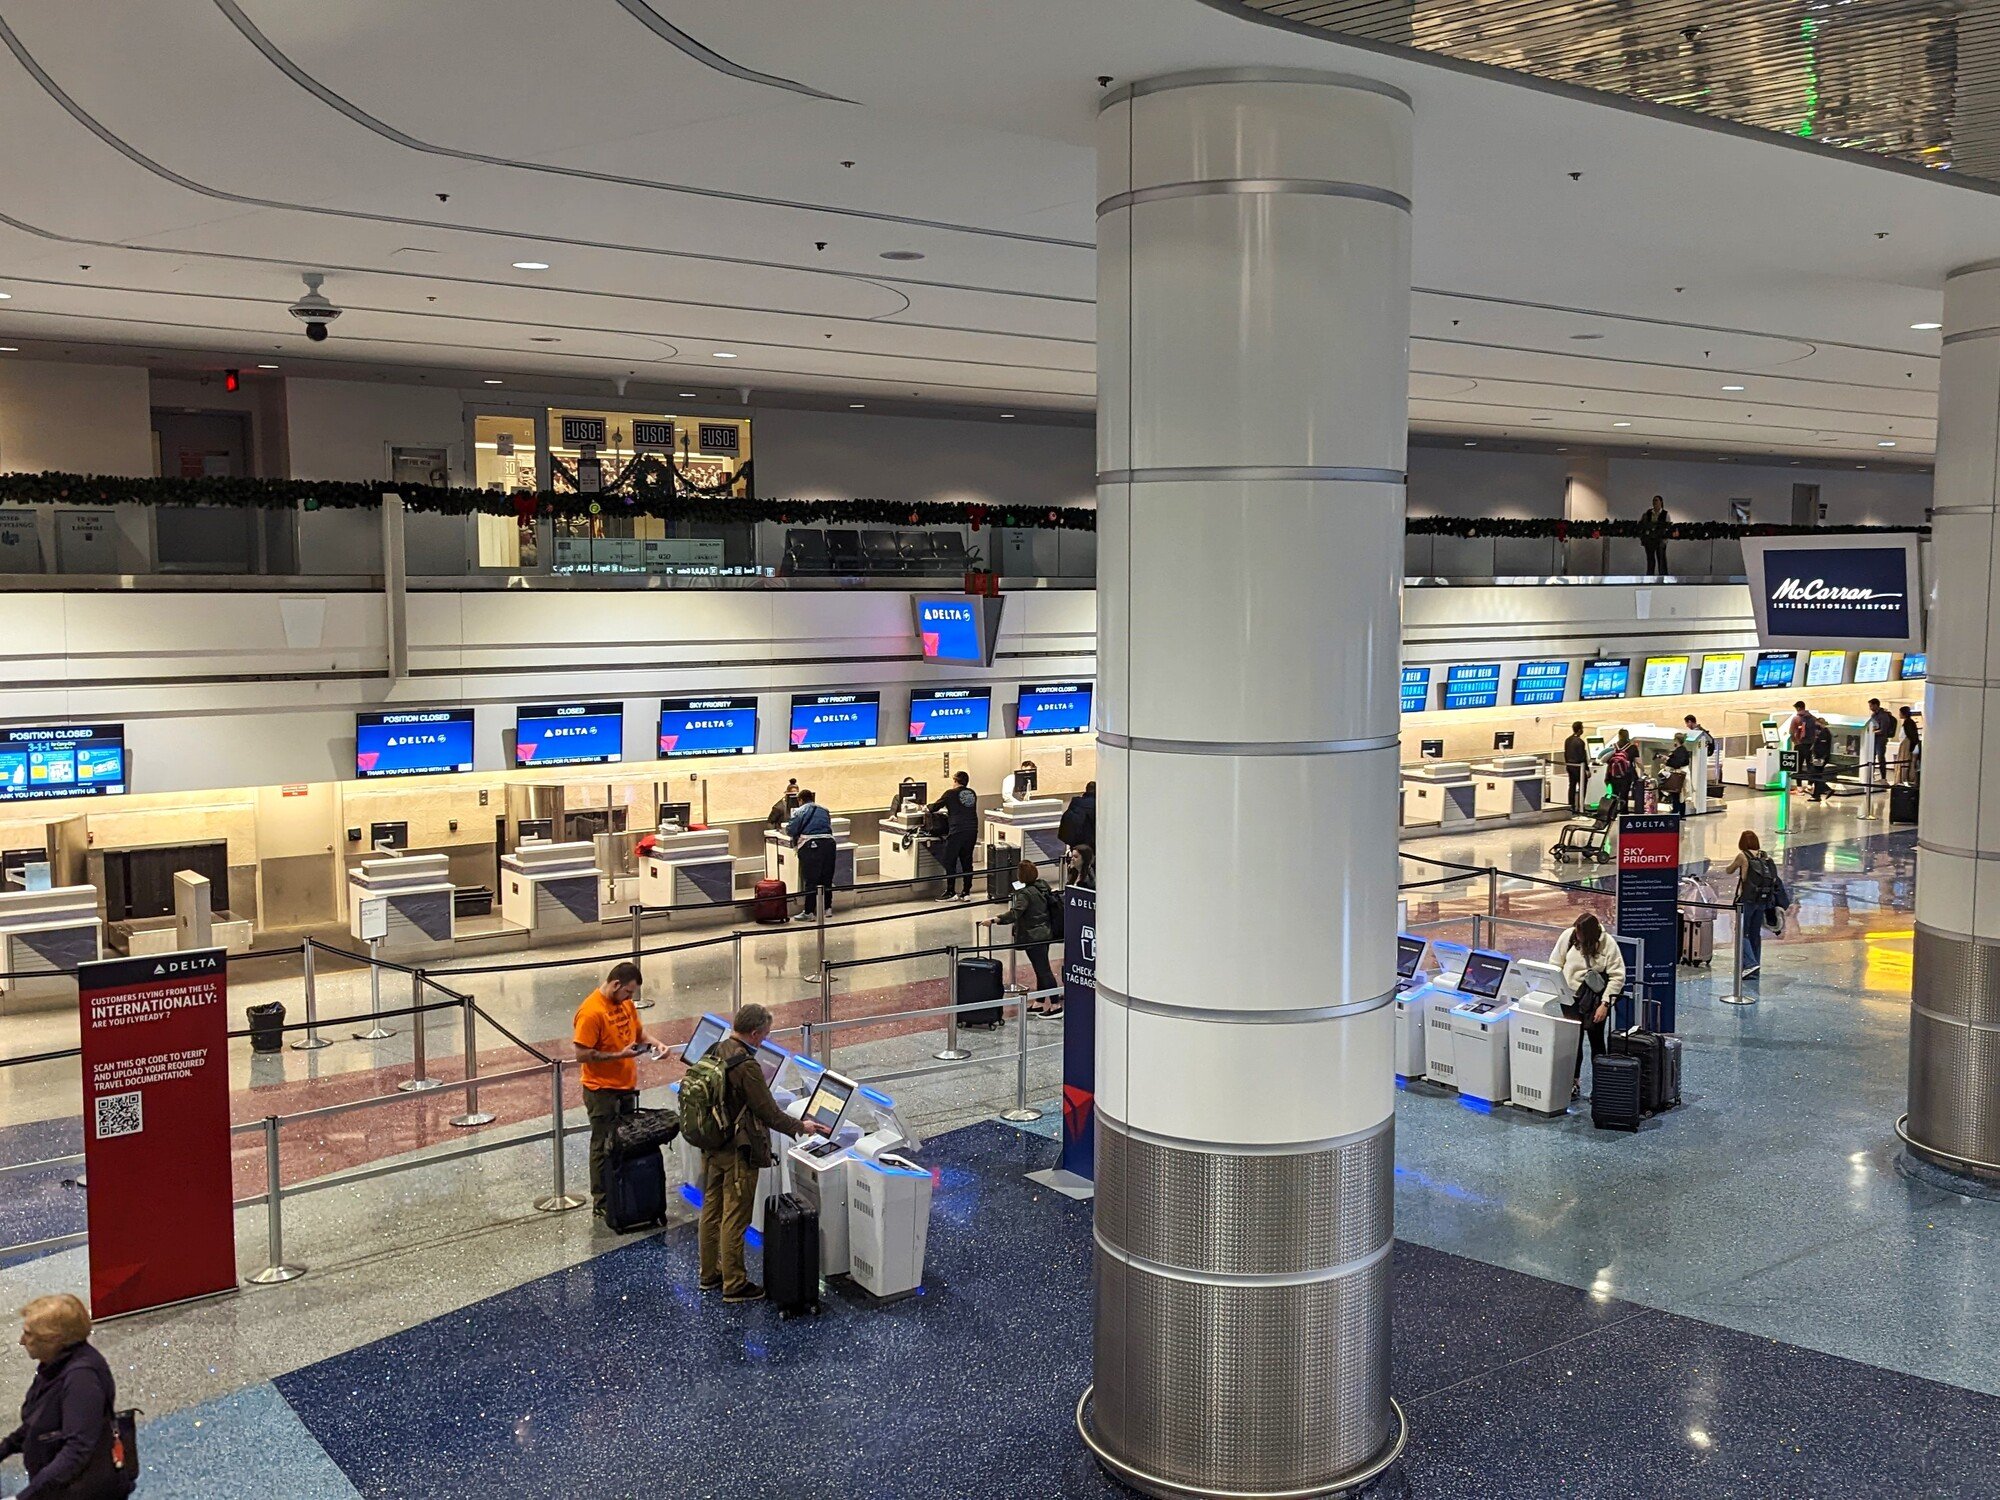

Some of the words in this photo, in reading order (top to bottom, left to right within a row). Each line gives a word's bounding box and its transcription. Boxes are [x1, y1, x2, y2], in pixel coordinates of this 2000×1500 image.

[572, 422, 596, 440] USO
[642, 425, 665, 442] USO
[707, 430, 729, 446] USO
[1772, 578, 1902, 600] McCarran
[932, 609, 961, 620] DELTA
[1456, 697, 1466, 706] LAS
[1468, 696, 1487, 705] VEGAS
[1524, 693, 1535, 702] LAS
[1536, 692, 1554, 701] VEGAS
[695, 720, 724, 728] DELTA
[10, 731, 53, 740] POSITION
[55, 729, 93, 739] CLOSED
[555, 727, 588, 736] DELTA
[399, 736, 435, 744] DELTA
[28, 742, 50, 752] 3-1-1
[1623, 848, 1644, 856] SKY
[1623, 855, 1671, 863] PRIORITY
[1078, 899, 1096, 910] DELT
[170, 958, 216, 972] DELTA
[1072, 964, 1095, 978] CHECK-
[1066, 973, 1079, 984] TAG
[1080, 977, 1096, 988] BAGS
[91, 994, 136, 1006] CUSTOMERS
[138, 990, 164, 1000] FLYING
[166, 988, 187, 996] FROM
[203, 983, 216, 992] U.S.
[92, 992, 217, 1020] INTERNATIONALLY:
[92, 1020, 107, 1029] ARE
[109, 1018, 125, 1026] YOU
[94, 1063, 115, 1073] SCAN
[116, 1060, 134, 1070] THIS
[135, 1058, 146, 1067] QR
[148, 1054, 168, 1064] CODE
[169, 1053, 180, 1061] TO
[181, 1048, 207, 1060] VERIFY
[94, 1072, 111, 1082] AND
[113, 1068, 143, 1080] UPLOAD
[145, 1064, 166, 1074] YOUR
[167, 1058, 205, 1070] REQUIRED
[94, 1080, 123, 1091] TRAVEL
[125, 1069, 192, 1086] DOCUMENTATION.
